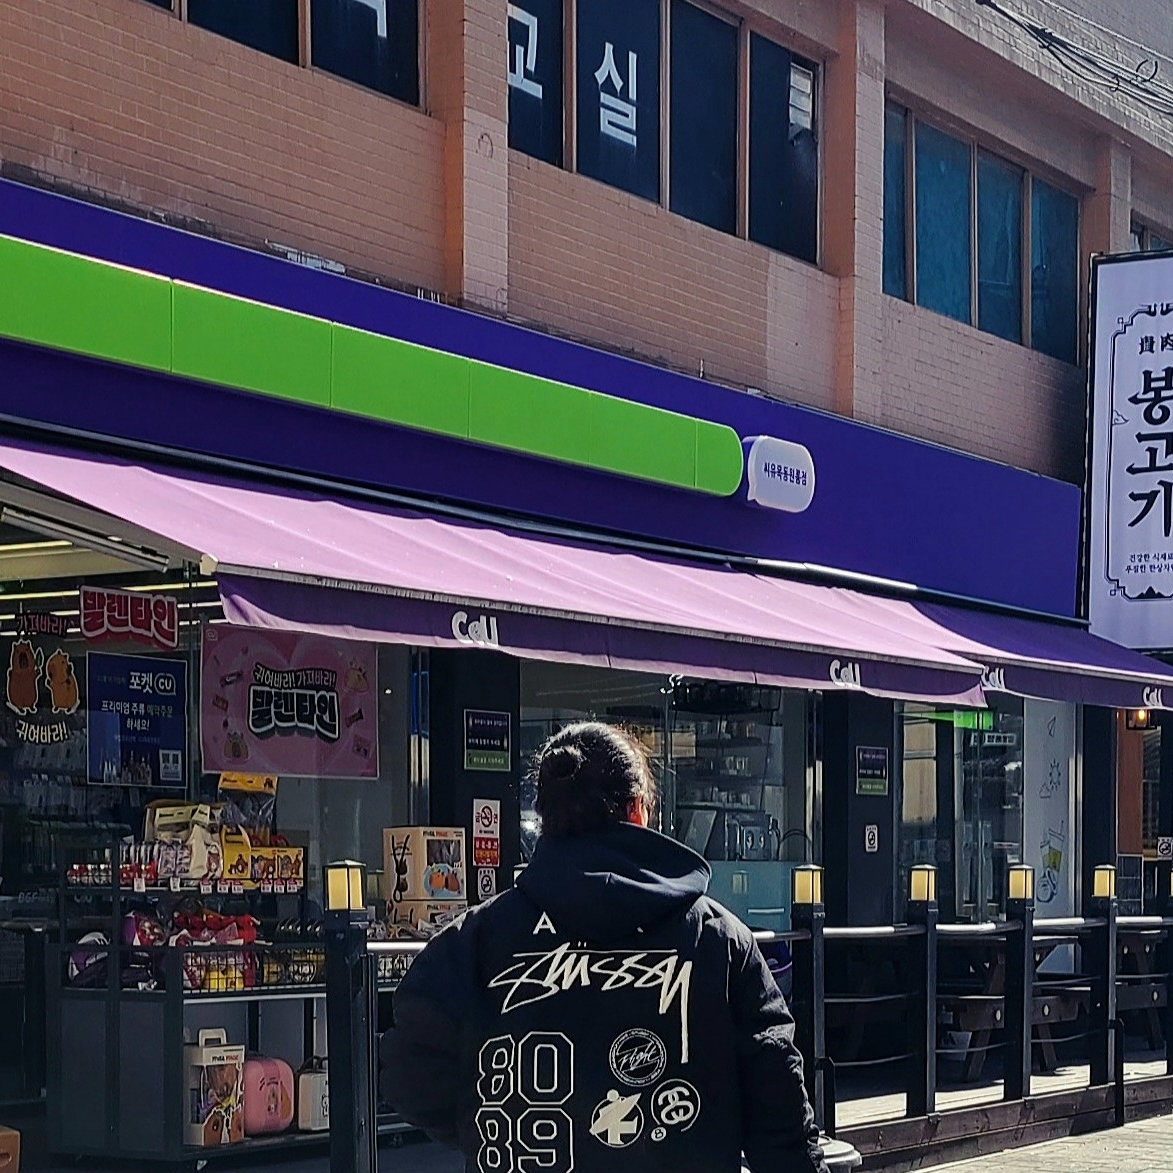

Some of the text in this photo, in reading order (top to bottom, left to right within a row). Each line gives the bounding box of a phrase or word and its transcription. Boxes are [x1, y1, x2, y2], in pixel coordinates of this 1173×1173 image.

[81, 586, 178, 648] 발렌타인
[129, 671, 153, 694] 포켓
[101, 700, 130, 715] 프리미엄
[250, 686, 339, 739] 발렌타인
[126, 718, 150, 731] 하세요!
[532, 911, 556, 934] A
[477, 1032, 573, 1105] 80
